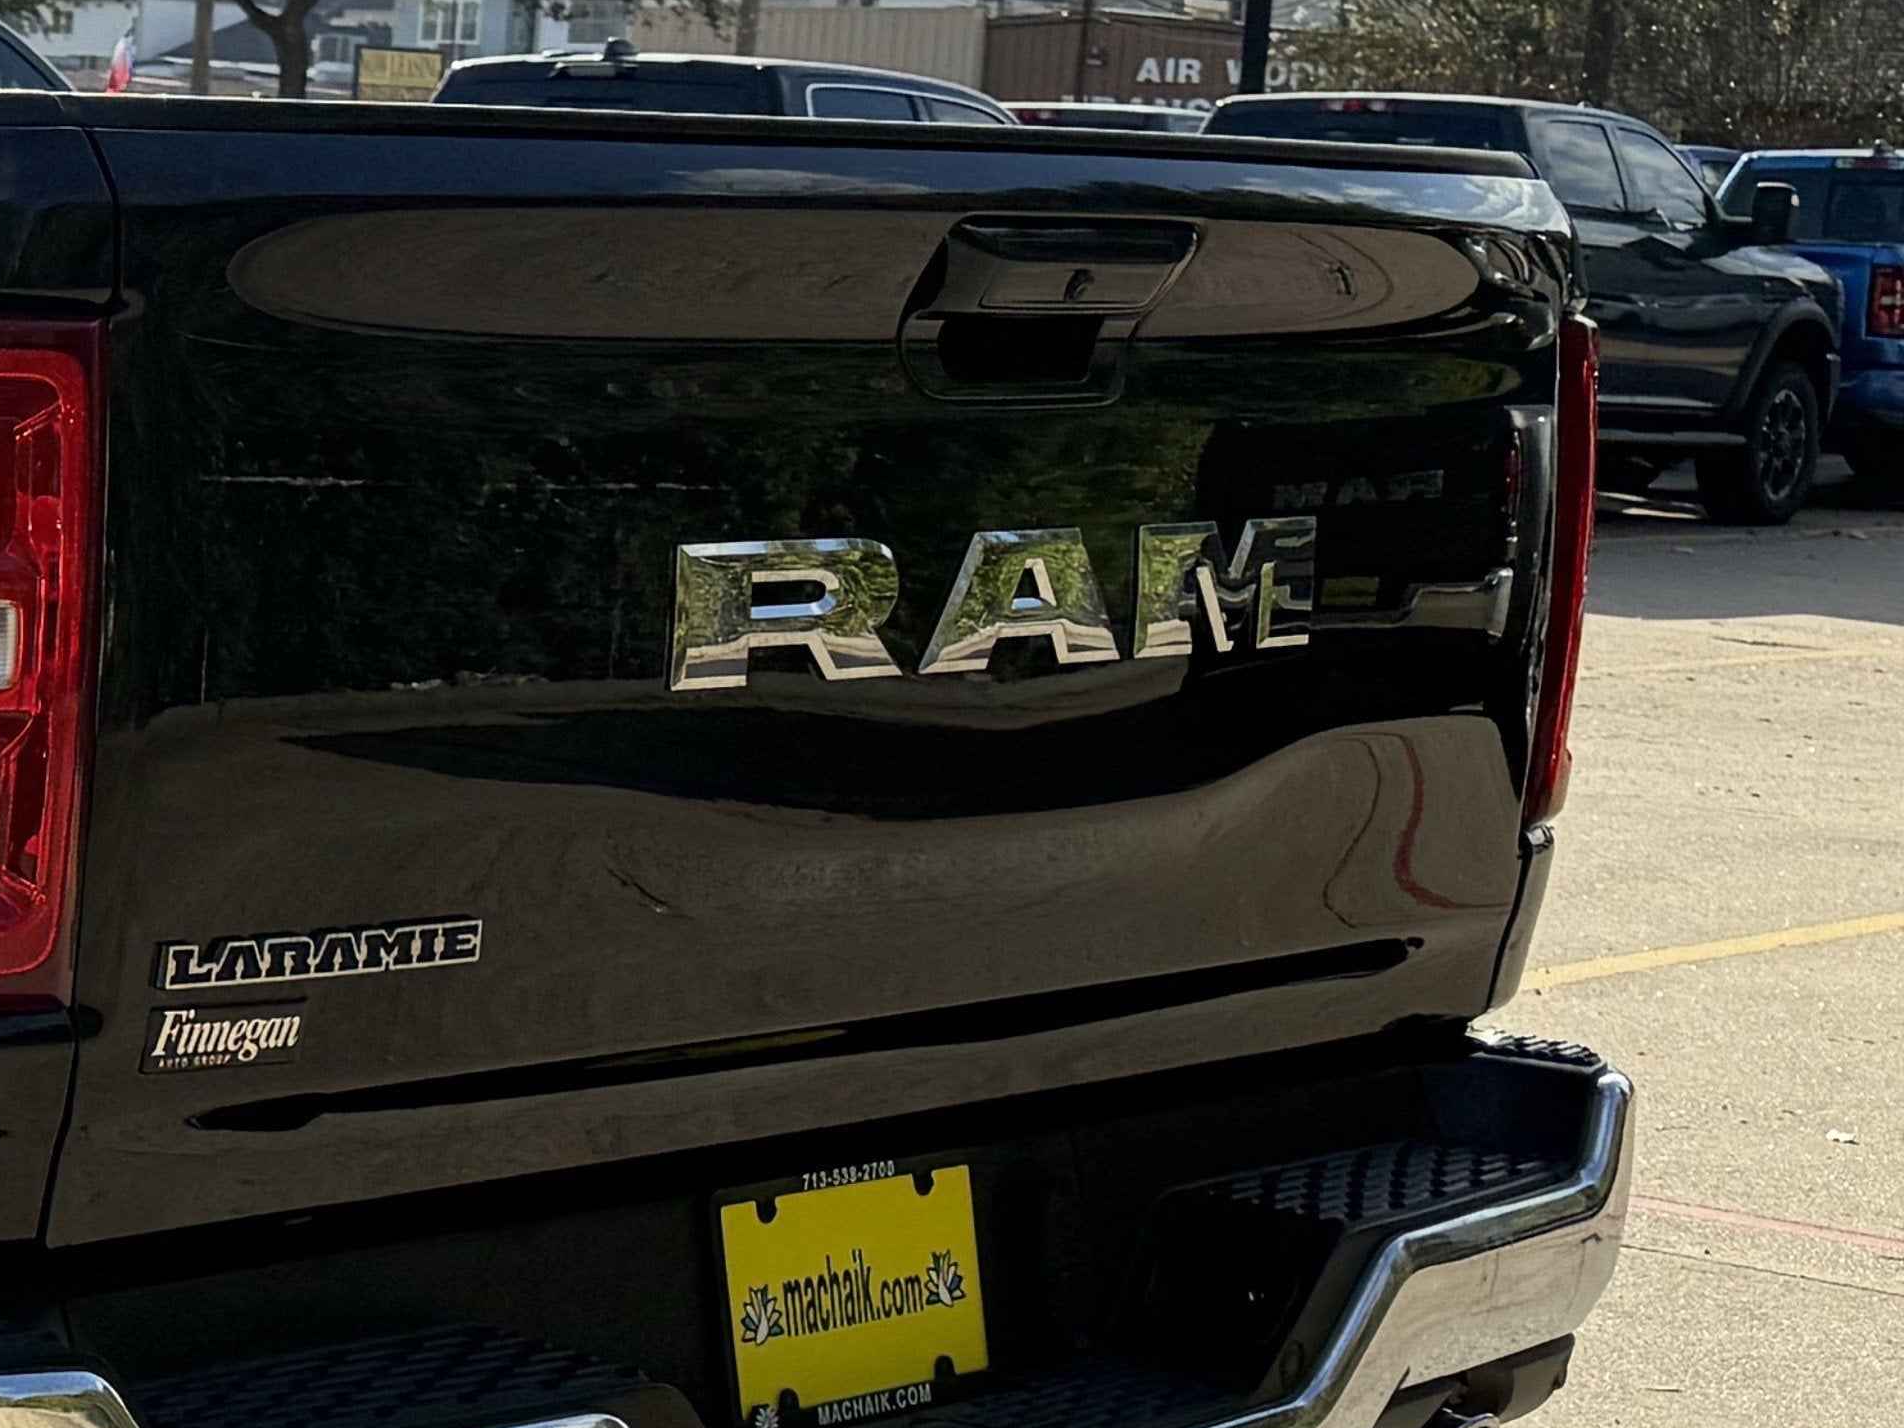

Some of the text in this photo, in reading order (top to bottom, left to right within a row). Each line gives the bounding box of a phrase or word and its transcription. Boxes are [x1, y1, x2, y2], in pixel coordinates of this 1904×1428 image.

[1136, 57, 1202, 85] AIR
[669, 515, 1318, 692] RAM
[159, 919, 483, 990] LARAMIE
[150, 1008, 301, 1062] Finnegan
[782, 1248, 925, 1338] machaik.com
[817, 1383, 932, 1425] MACHAIK.COM
